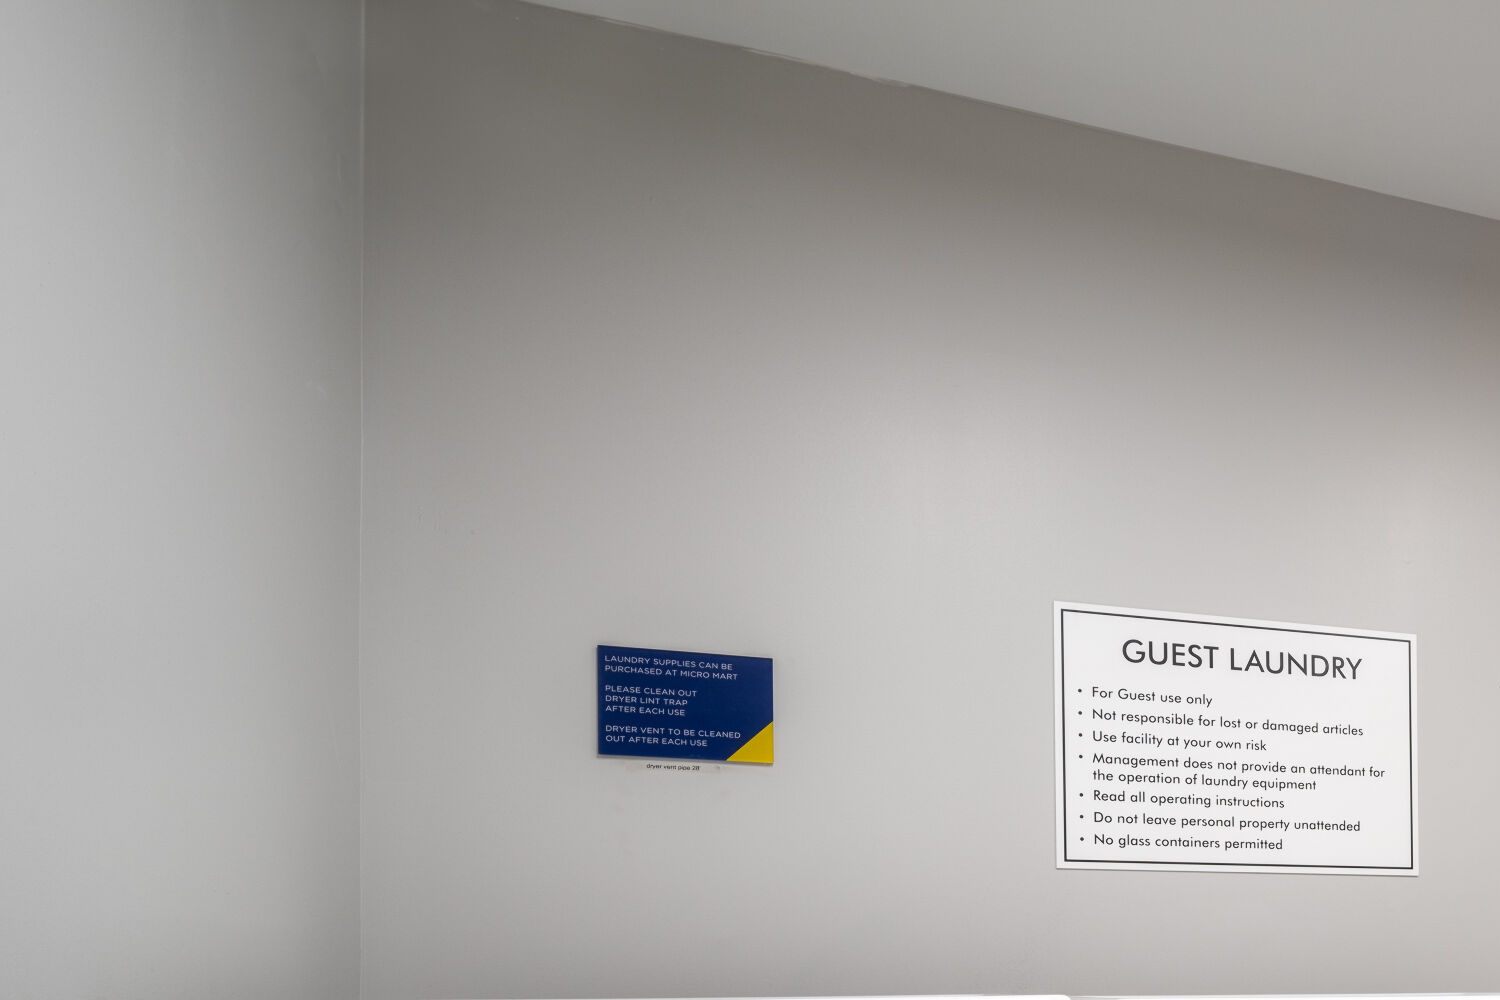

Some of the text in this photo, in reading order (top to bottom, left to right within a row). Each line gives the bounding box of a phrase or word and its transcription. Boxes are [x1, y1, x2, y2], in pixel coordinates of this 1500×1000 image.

[605, 656, 650, 664] LAUNDRY
[653, 659, 696, 668] SUPPLIES
[1122, 638, 1362, 680] GUEST LAUNDRY
[605, 666, 662, 676] PURCHASED
[605, 685, 641, 693] PLEASE
[1092, 687, 1213, 707] For Guest use only
[605, 695, 637, 703] DRYER
[639, 707, 665, 715] EACH
[606, 725, 638, 733] DRYER
[698, 730, 741, 738] CLEANED
[1092, 709, 1363, 737] Not responsible for lost or damaged articles
[606, 735, 625, 743] OUT
[690, 739, 707, 747] USE
[1092, 731, 1267, 751] Use facility at your own risk
[1093, 753, 1385, 778] Management does not provide an attendant for
[1093, 770, 1316, 792] the operation of laundry equipment
[1093, 790, 1285, 808] Read all operating instructions
[1094, 812, 1361, 832] Do not leave personal property unattended
[1094, 834, 1283, 851] No glass containers permitted
